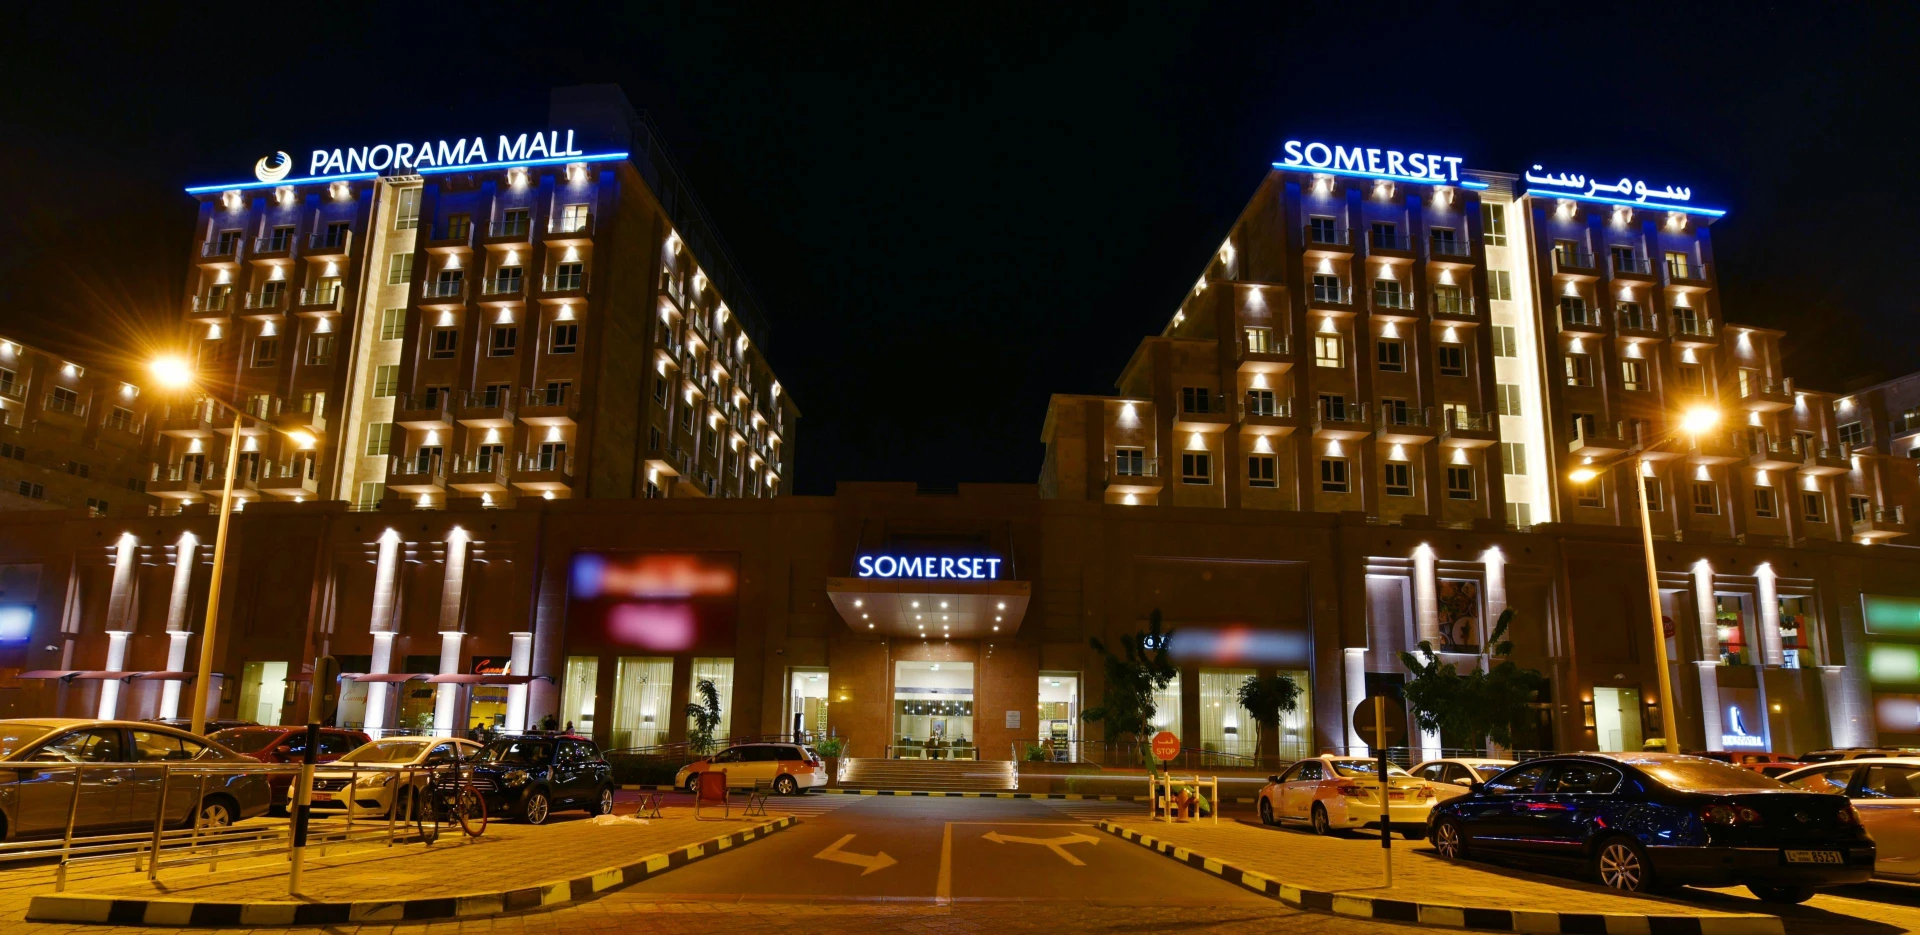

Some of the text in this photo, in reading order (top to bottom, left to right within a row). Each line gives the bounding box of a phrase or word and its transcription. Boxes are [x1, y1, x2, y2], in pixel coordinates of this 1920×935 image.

[309, 129, 583, 176] PANORAMA MALL
[1284, 140, 1463, 181] SOMERSET
[1525, 164, 1691, 203] سومرست
[858, 555, 1001, 579] SOMERSET
[1156, 747, 1176, 755] STOP
[1811, 851, 1841, 863] 85251
